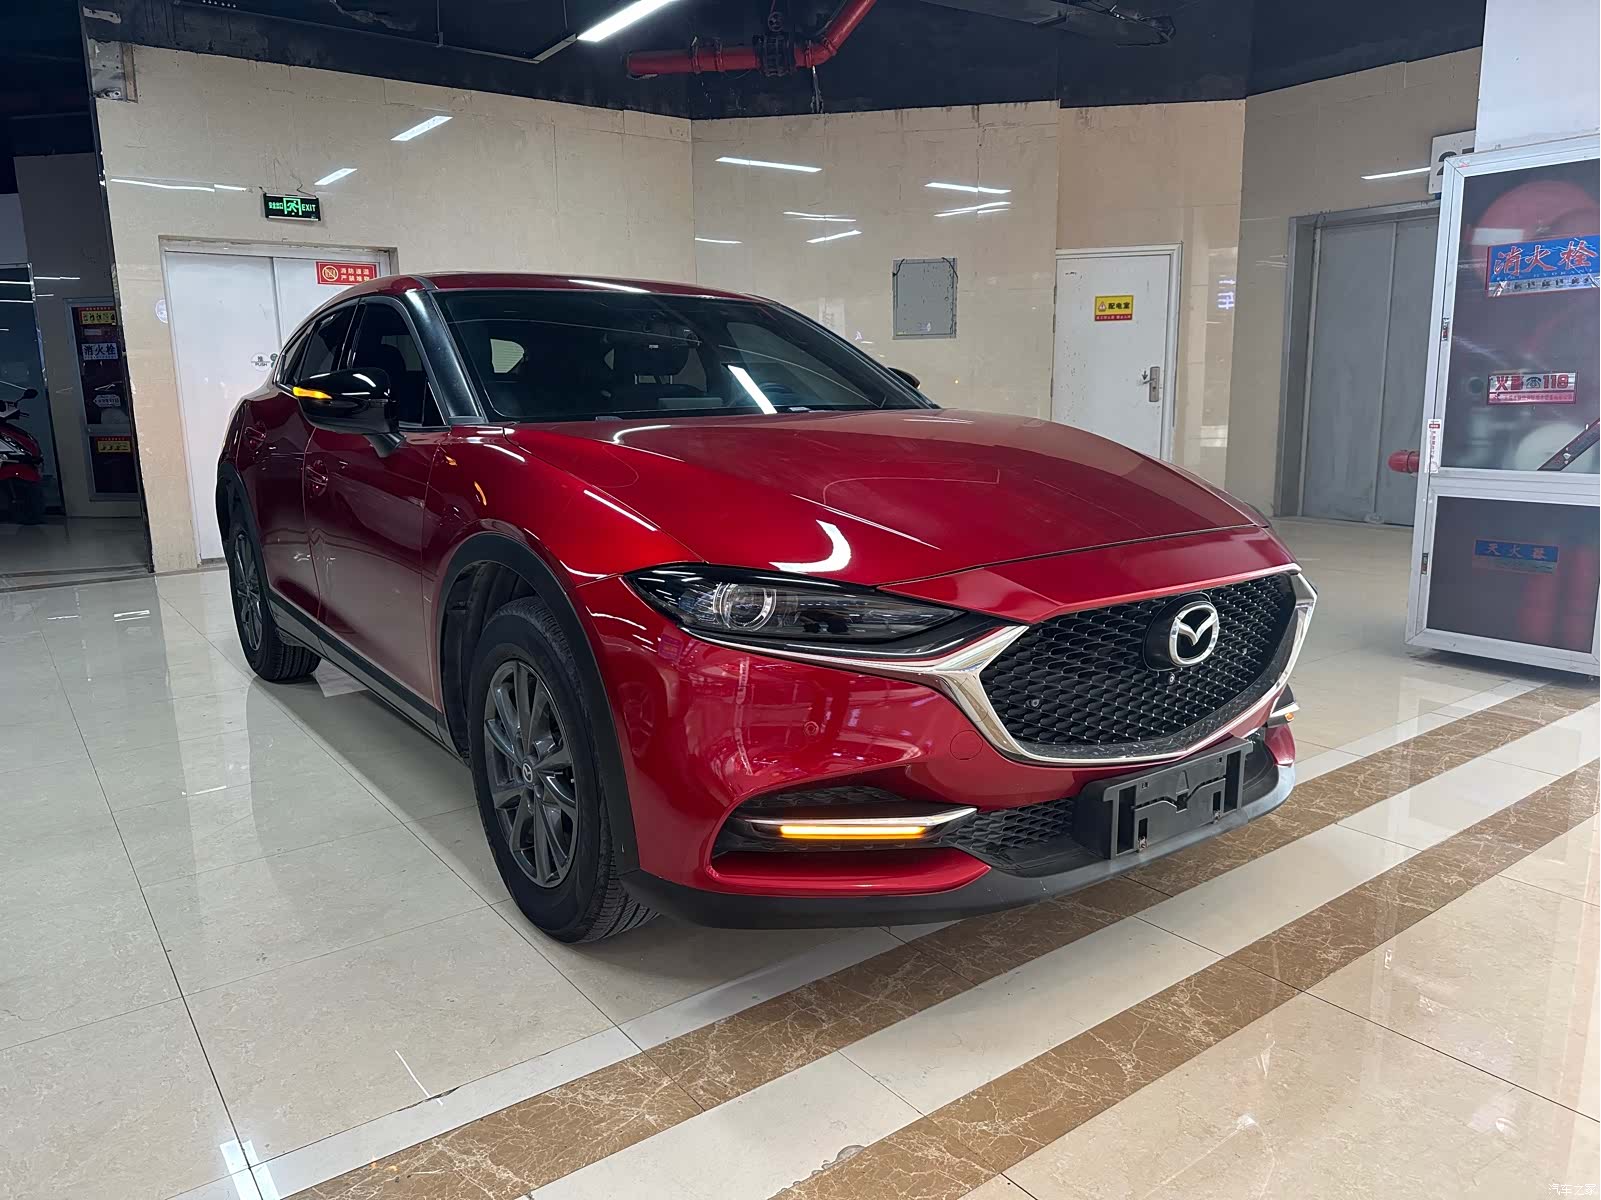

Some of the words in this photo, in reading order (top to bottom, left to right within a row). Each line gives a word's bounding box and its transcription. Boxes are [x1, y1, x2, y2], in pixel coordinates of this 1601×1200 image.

[1494, 240, 1598, 276] 消火栓
[83, 343, 116, 356] 消火栓
